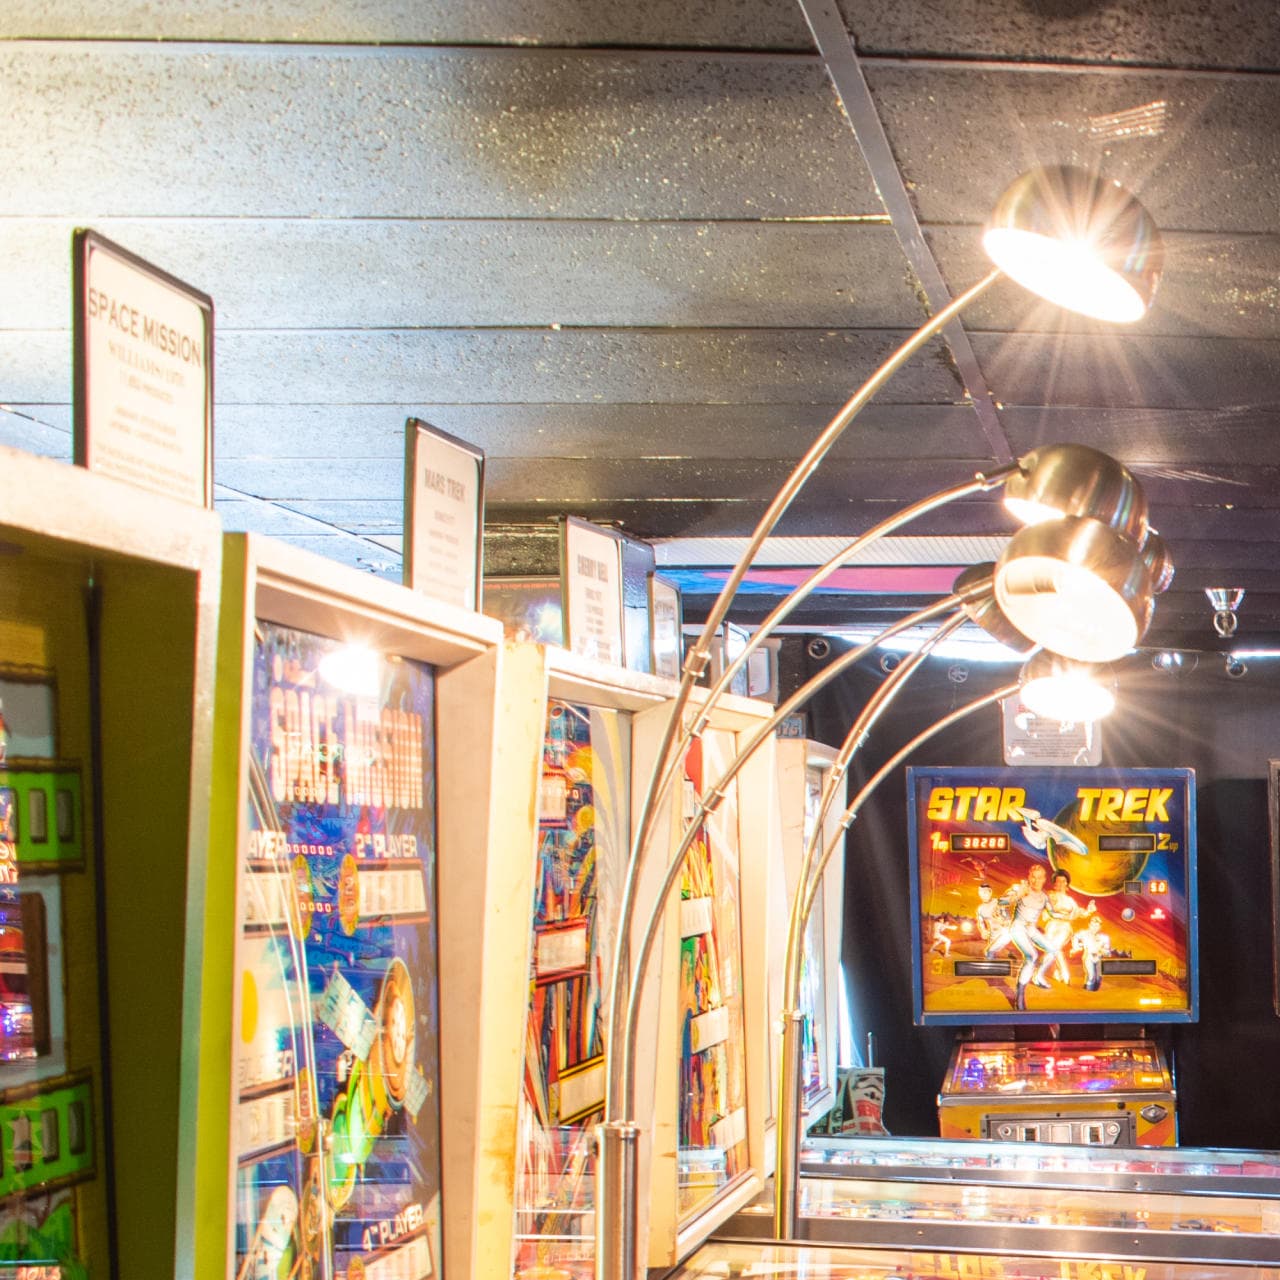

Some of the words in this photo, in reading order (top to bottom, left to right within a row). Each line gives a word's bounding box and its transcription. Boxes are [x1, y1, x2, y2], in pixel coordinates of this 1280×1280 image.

[87, 286, 139, 340] SPACE
[142, 313, 202, 370] MISSION
[927, 785, 1027, 822] STAR
[1076, 786, 1174, 822] TREK
[373, 833, 419, 858] PLAYER
[379, 1204, 423, 1246] PLAYER
